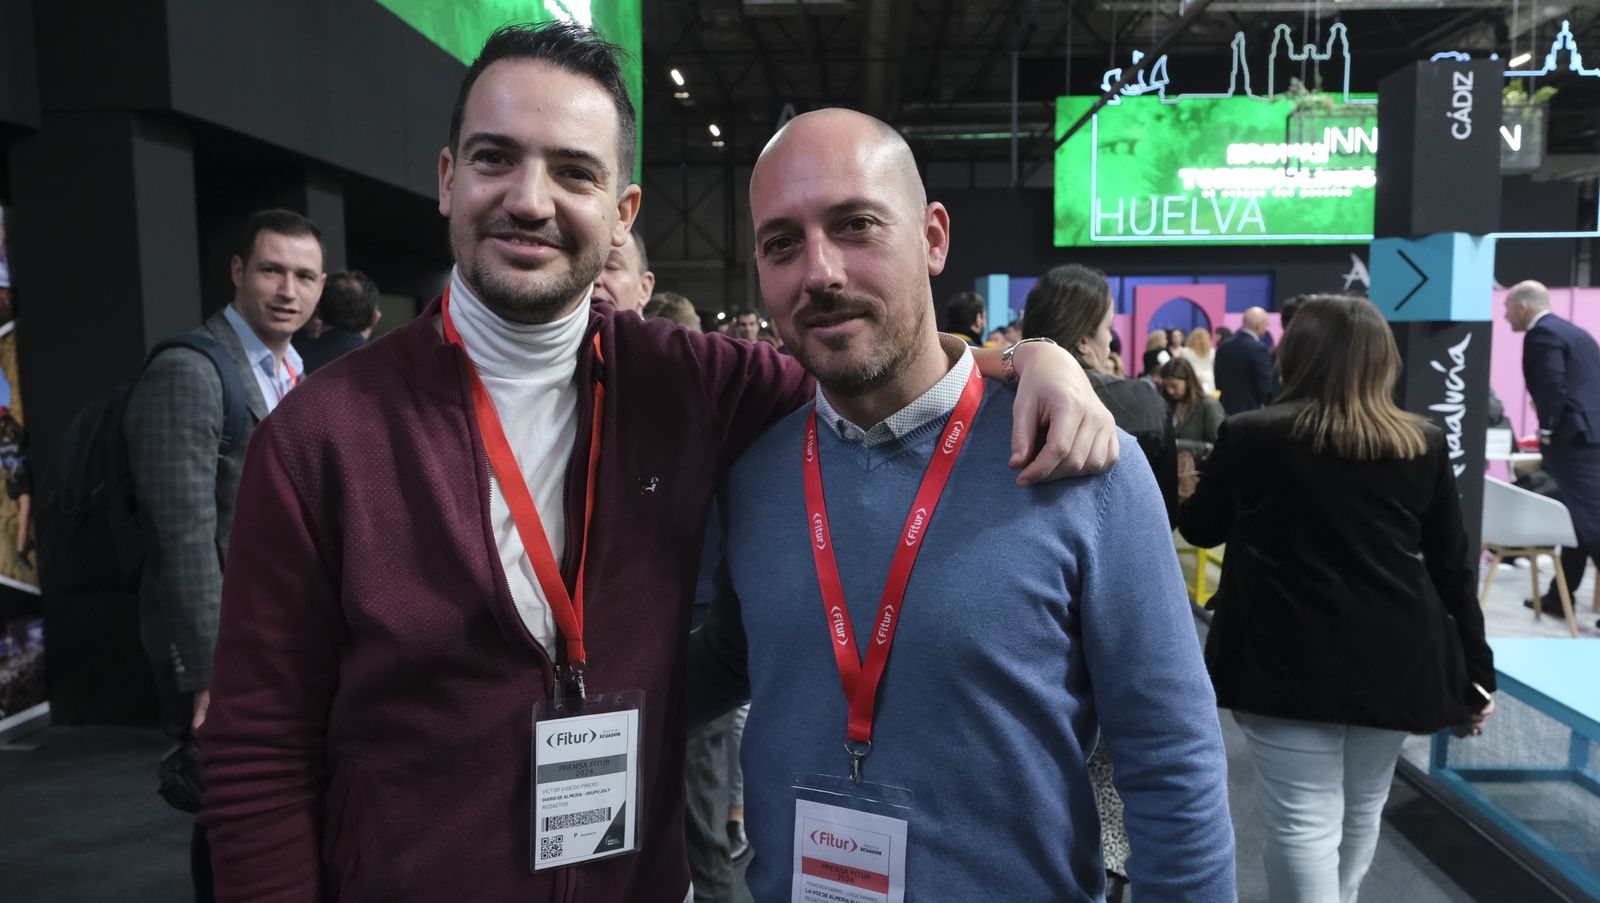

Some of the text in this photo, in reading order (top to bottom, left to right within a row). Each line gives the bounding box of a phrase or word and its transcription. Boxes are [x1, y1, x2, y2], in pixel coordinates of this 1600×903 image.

[1446, 70, 1475, 141] CÁDIZ
[1096, 196, 1267, 236] HUELVA
[559, 758, 610, 772] PRENSA FITUR
[576, 768, 594, 777] 2024
[860, 847, 882, 855] ECUADOR
[821, 863, 871, 880] PRENSA FITUR
[837, 873, 854, 883] 2024
